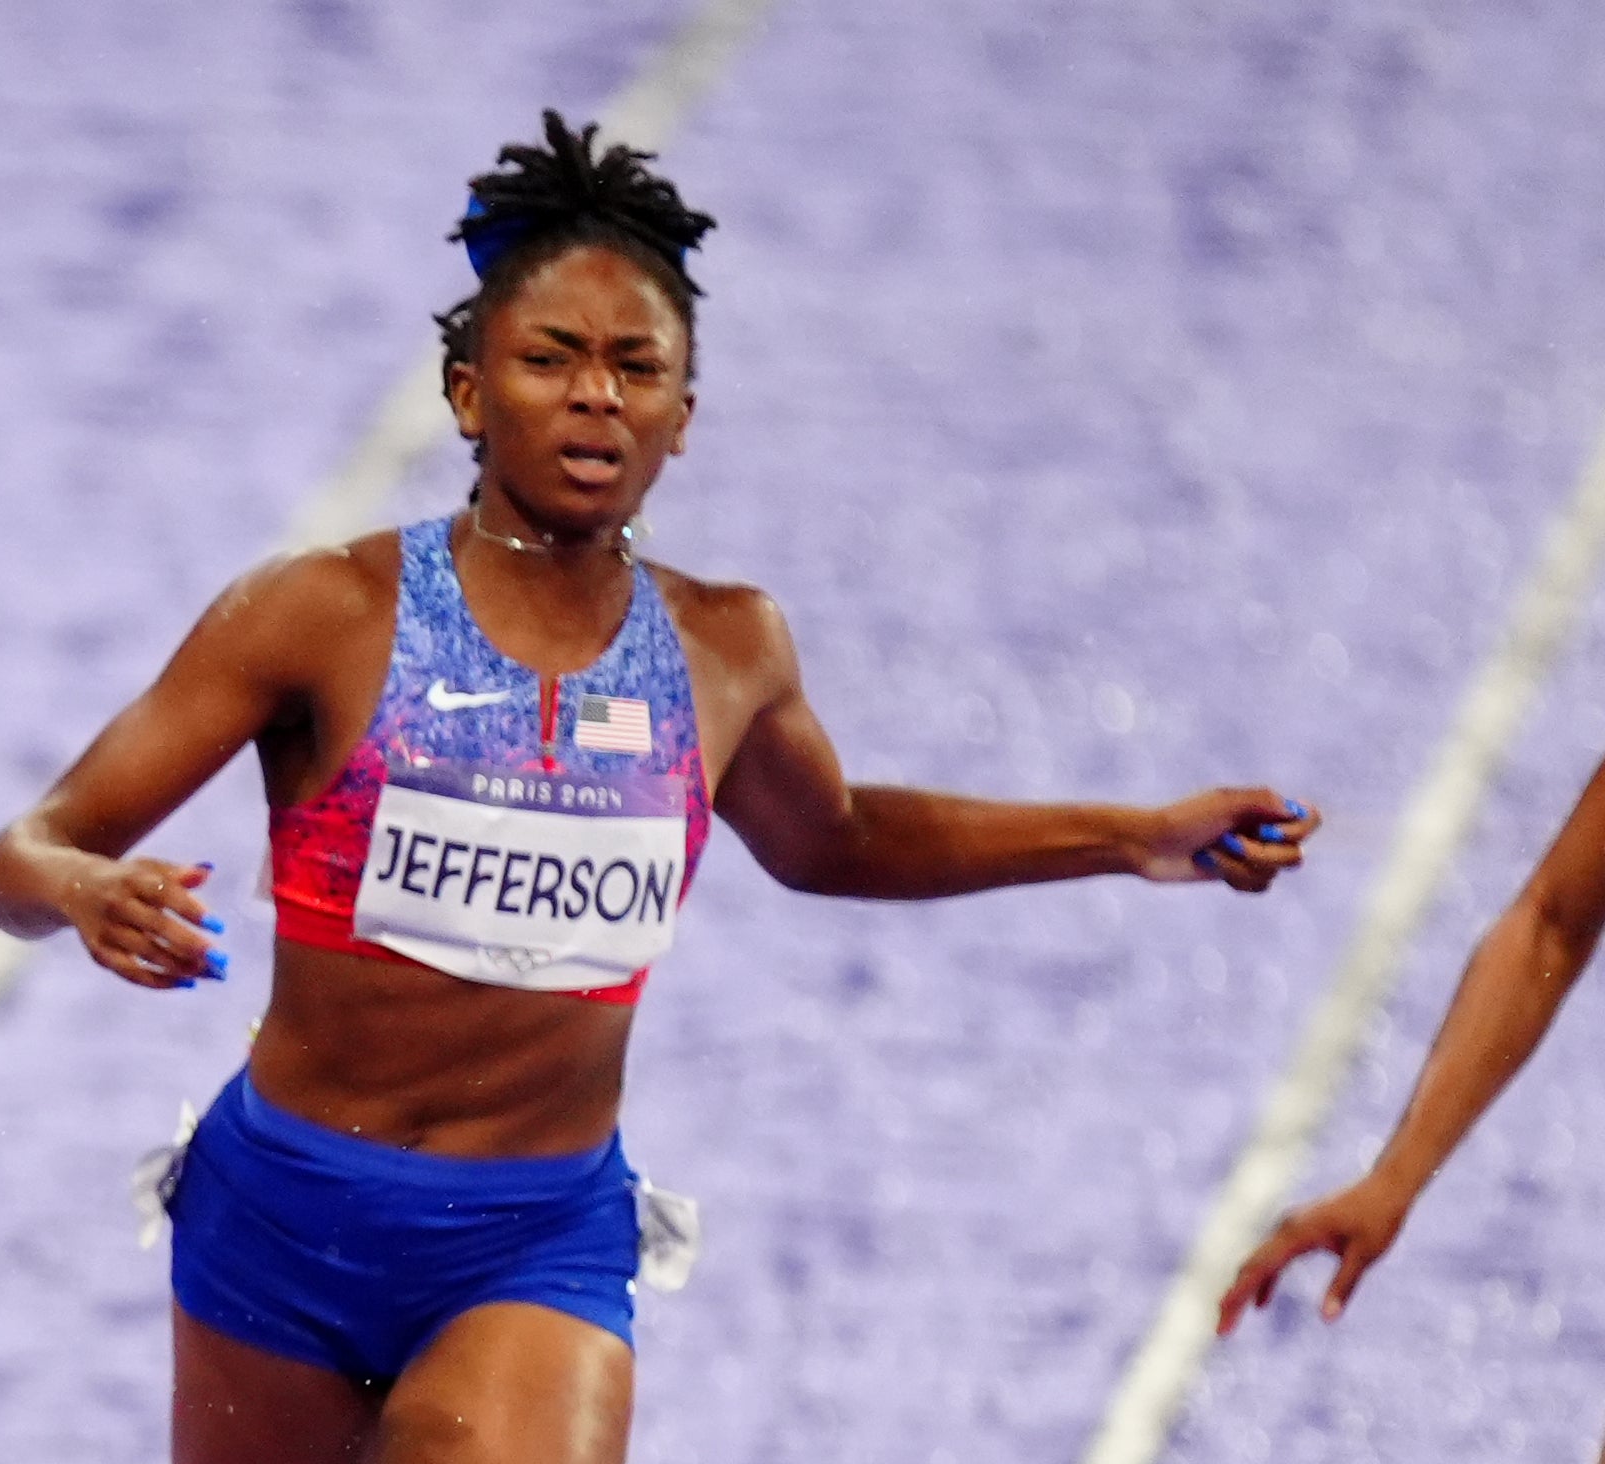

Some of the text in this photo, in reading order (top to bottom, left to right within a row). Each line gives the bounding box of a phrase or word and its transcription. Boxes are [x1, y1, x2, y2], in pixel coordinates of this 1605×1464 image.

[472, 774, 624, 810] PARIS 2024
[377, 827, 675, 923] JEFFERSON
